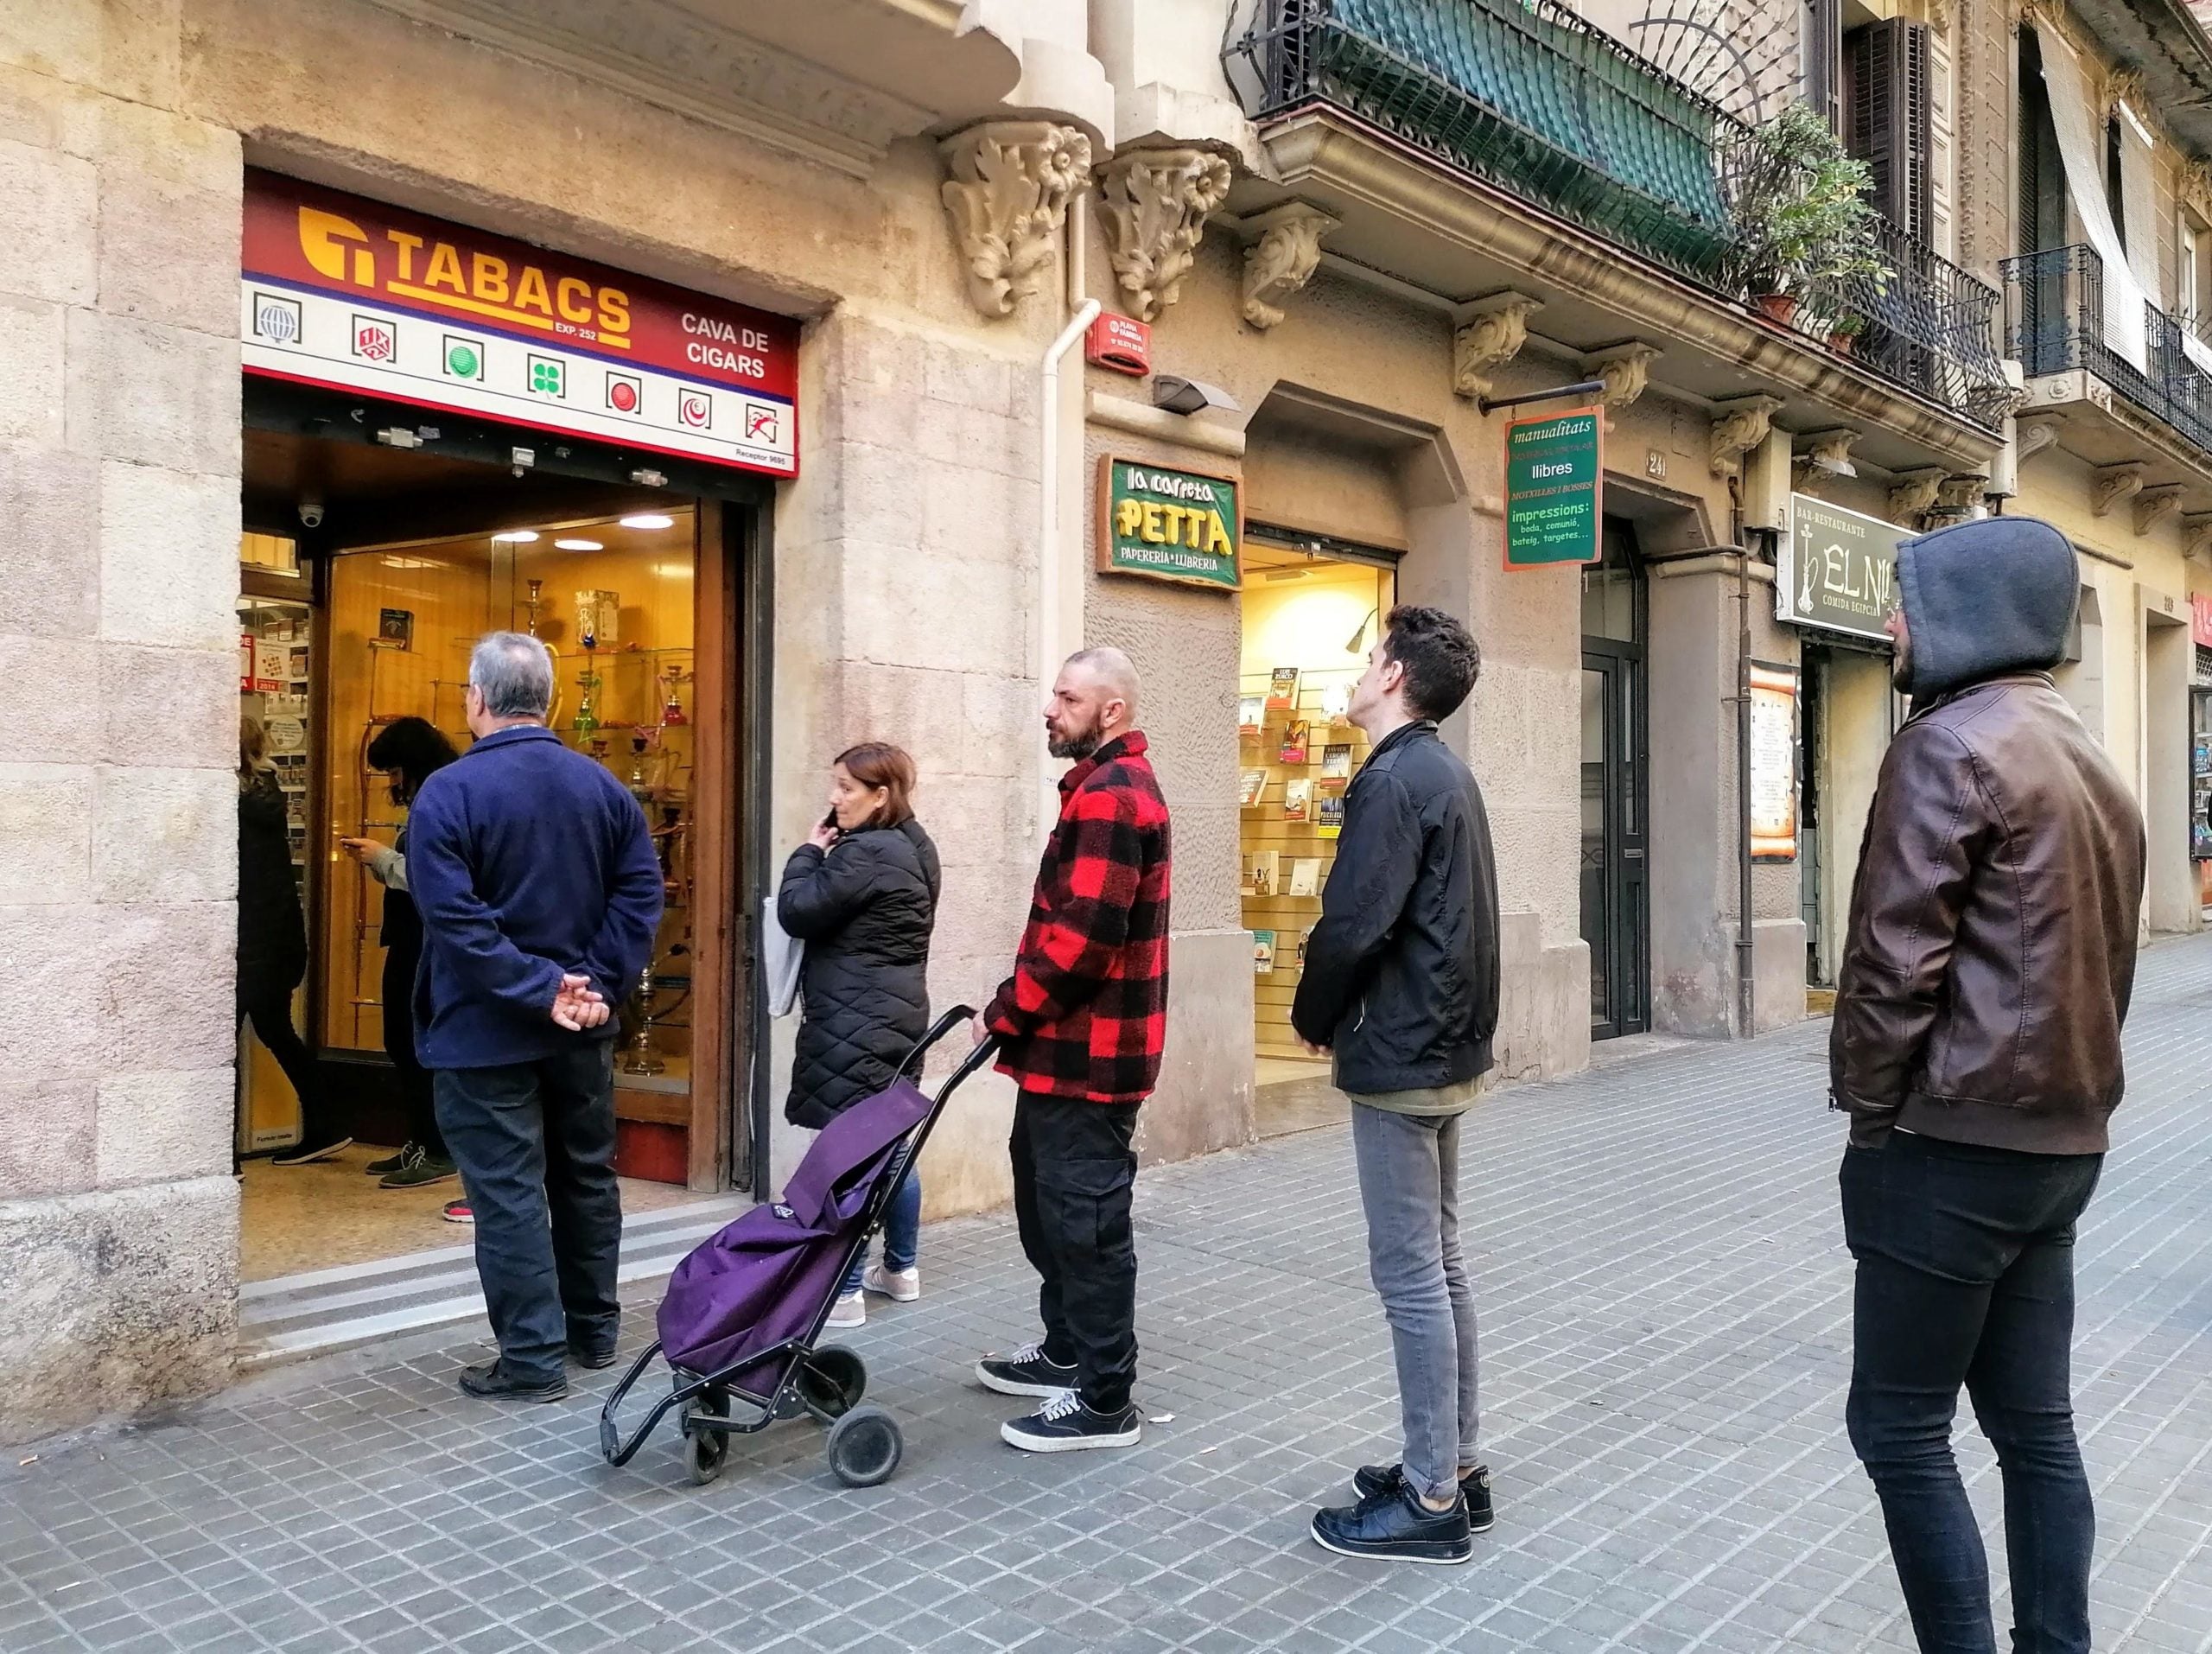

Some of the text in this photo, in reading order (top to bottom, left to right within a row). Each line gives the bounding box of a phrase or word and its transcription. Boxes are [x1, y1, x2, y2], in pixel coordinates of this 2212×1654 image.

[387, 229, 631, 333] TABACS
[555, 322, 596, 340] EXP. 252
[682, 313, 769, 353] CAVA DE
[687, 343, 765, 379] CIGARS
[1514, 419, 1592, 443] manualitats
[735, 448, 767, 461] Receptor
[1532, 462, 1573, 480] llibres
[1127, 467, 1215, 501] la carpeta
[1511, 487, 1556, 500] MOTXILLES
[1562, 480, 1593, 493] BOSSES
[1512, 502, 1589, 525] impressions:
[1796, 506, 1866, 538] BAR-RESTAURANTE
[1116, 499, 1233, 557] PETTA
[1521, 518, 1580, 534] boda, comunió,
[1512, 531, 1589, 546] bateig, targetes...
[1121, 547, 1218, 571] PAPERERIA LLIBRERIA
[1823, 544, 1860, 597] EL
[1822, 594, 1878, 617] COMIDA EGIPCIA
